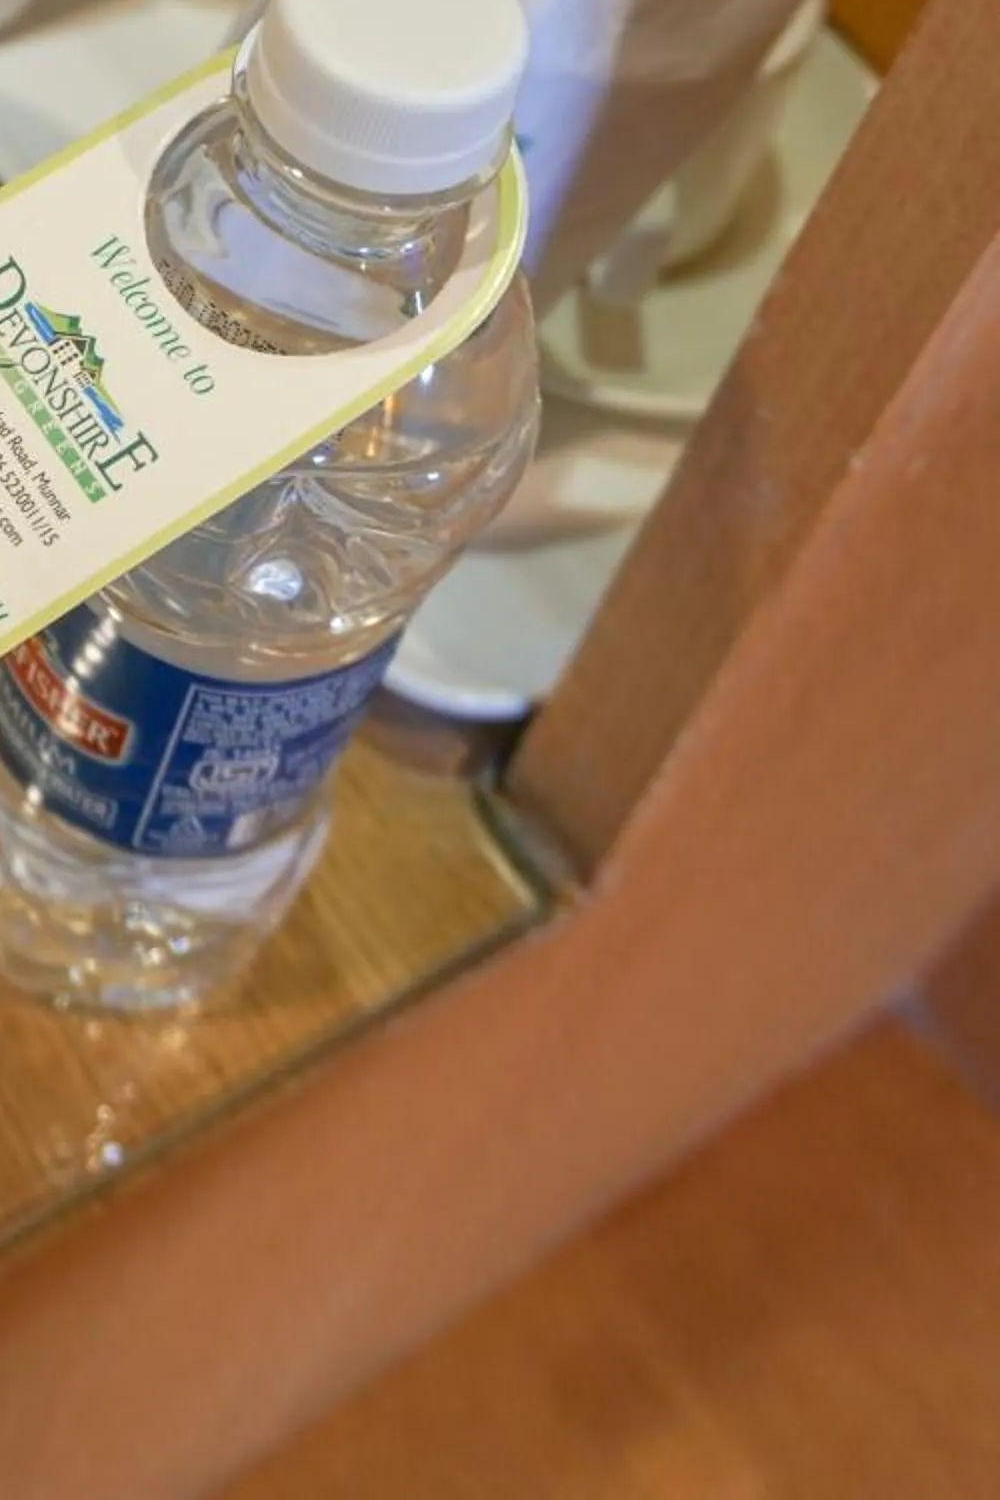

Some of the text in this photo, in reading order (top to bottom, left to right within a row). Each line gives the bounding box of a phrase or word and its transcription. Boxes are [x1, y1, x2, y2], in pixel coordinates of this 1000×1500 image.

[91, 236, 215, 395] Welcome to
[9, 374, 104, 501] GREENS
[31, 471, 71, 521] Munnar
